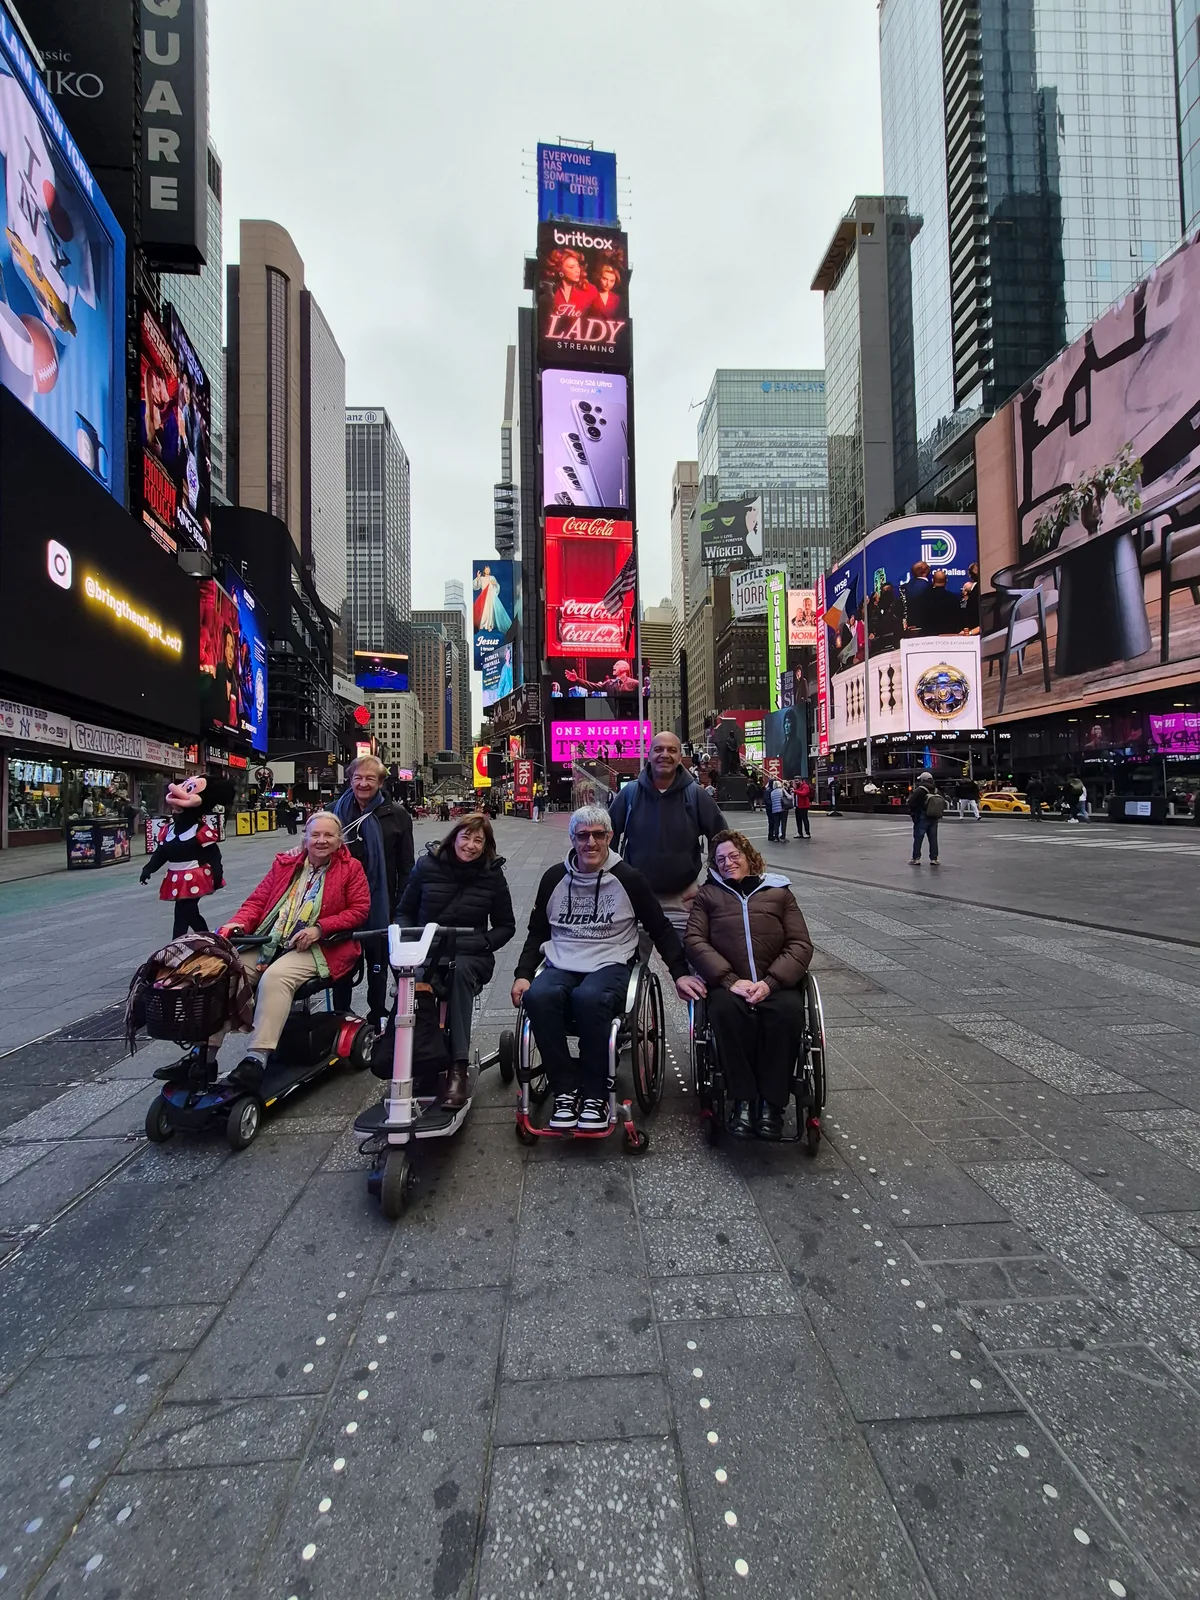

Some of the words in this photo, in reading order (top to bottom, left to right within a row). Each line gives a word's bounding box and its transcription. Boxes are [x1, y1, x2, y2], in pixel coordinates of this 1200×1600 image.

[39, 49, 71, 62] assic
[45, 69, 104, 98] IKO
[0, 13, 32, 87] LAM
[35, 76, 64, 140] NEW
[65, 131, 94, 198] YORK
[543, 149, 591, 166] EVERYONE
[543, 160, 562, 171] HAS
[543, 171, 598, 187] SOMETHING
[544, 181, 555, 190] TO
[554, 229, 613, 250] britbox
[556, 304, 582, 316] The
[545, 314, 625, 344] LADY
[557, 342, 615, 353] STREAMING
[560, 378, 584, 387] Galaxy
[774, 382, 825, 392] BARCLAYS
[345, 413, 363, 421] anz
[177, 506, 192, 533] KING
[193, 526, 207, 551] SEIKO
[562, 516, 616, 536] Coca-Cola
[736, 568, 763, 587] LITTLE
[942, 568, 966, 576] Dallas
[476, 631, 499, 647] Jesus
[773, 594, 781, 692] CANNABIS
[790, 632, 817, 640] NORM
[818, 639, 826, 694] CHOCOLATE
[0, 700, 21, 715] PORTS
[555, 726, 582, 736] ONE
[587, 726, 628, 736] NIGHT
[519, 761, 531, 785] tkts
[557, 911, 616, 925] ZUZENAK
